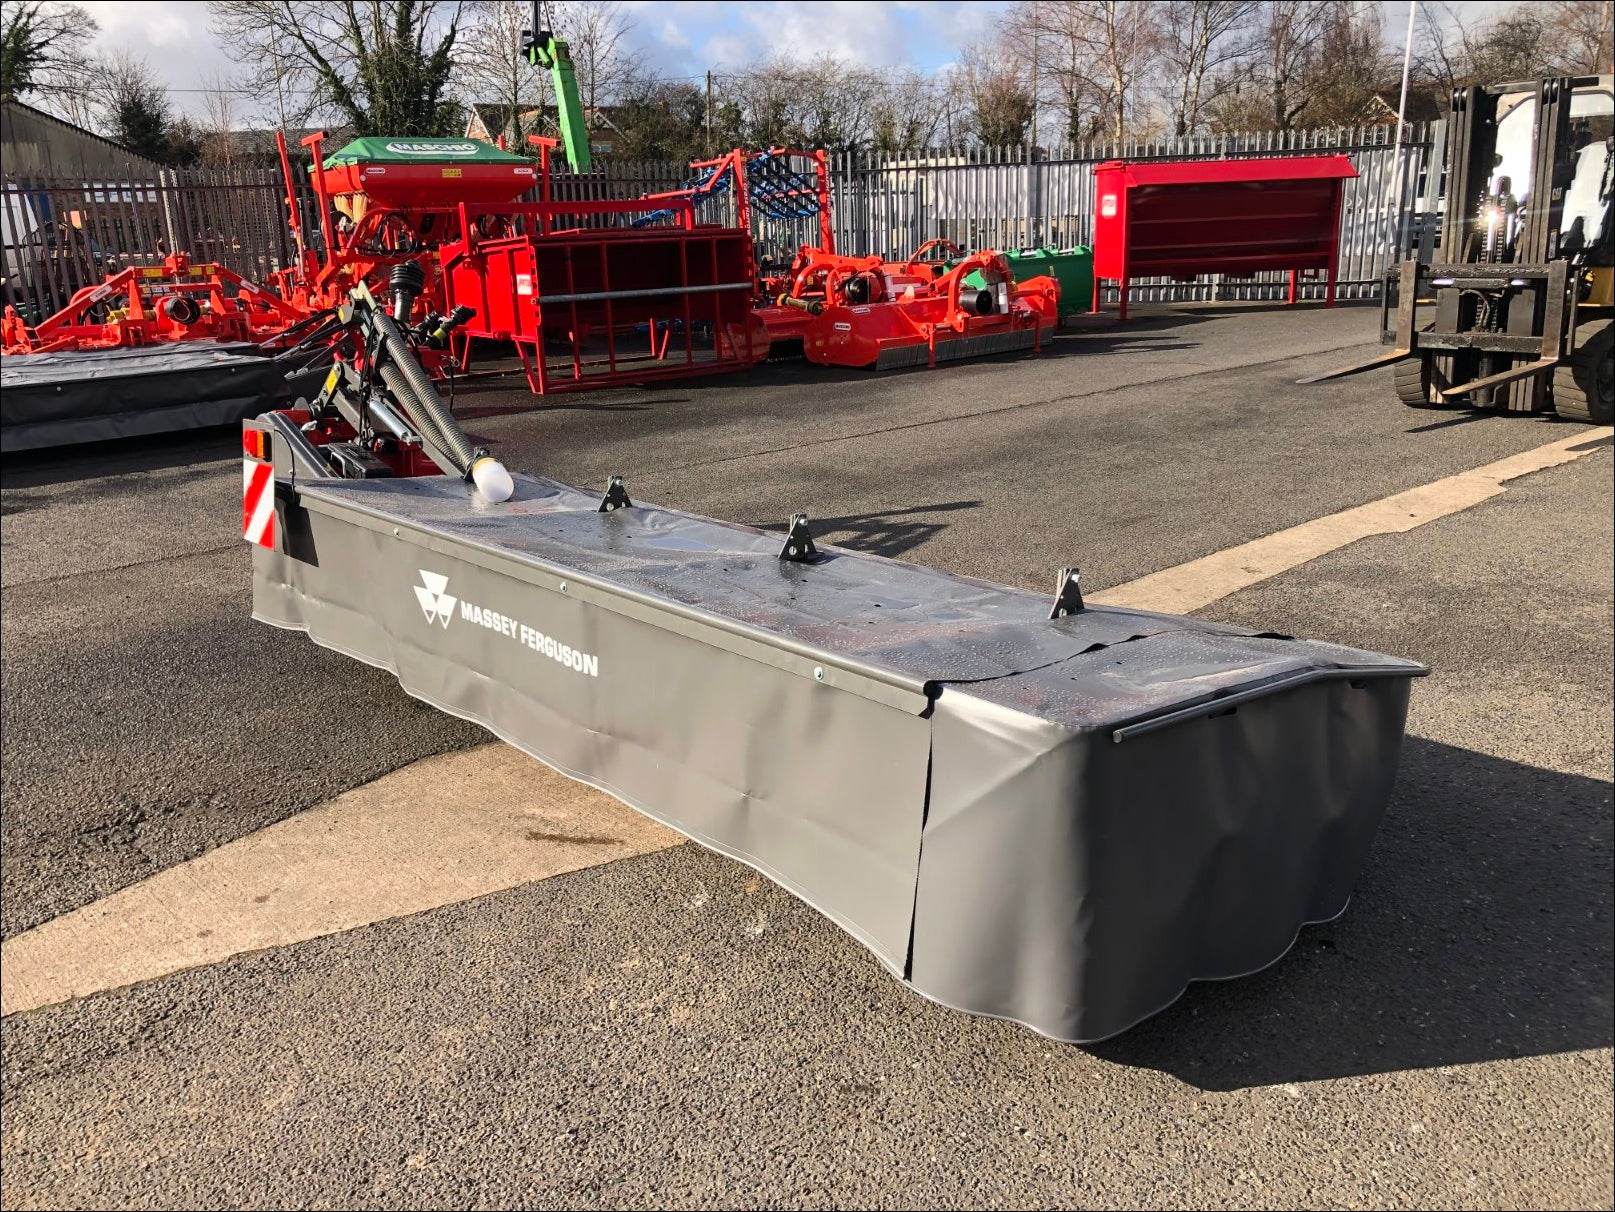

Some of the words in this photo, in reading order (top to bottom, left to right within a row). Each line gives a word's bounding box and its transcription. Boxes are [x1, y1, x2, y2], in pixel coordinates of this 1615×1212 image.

[394, 142, 476, 151] MASCHIO
[460, 600, 518, 639] MASSEY
[520, 624, 599, 677] FERGUSON
